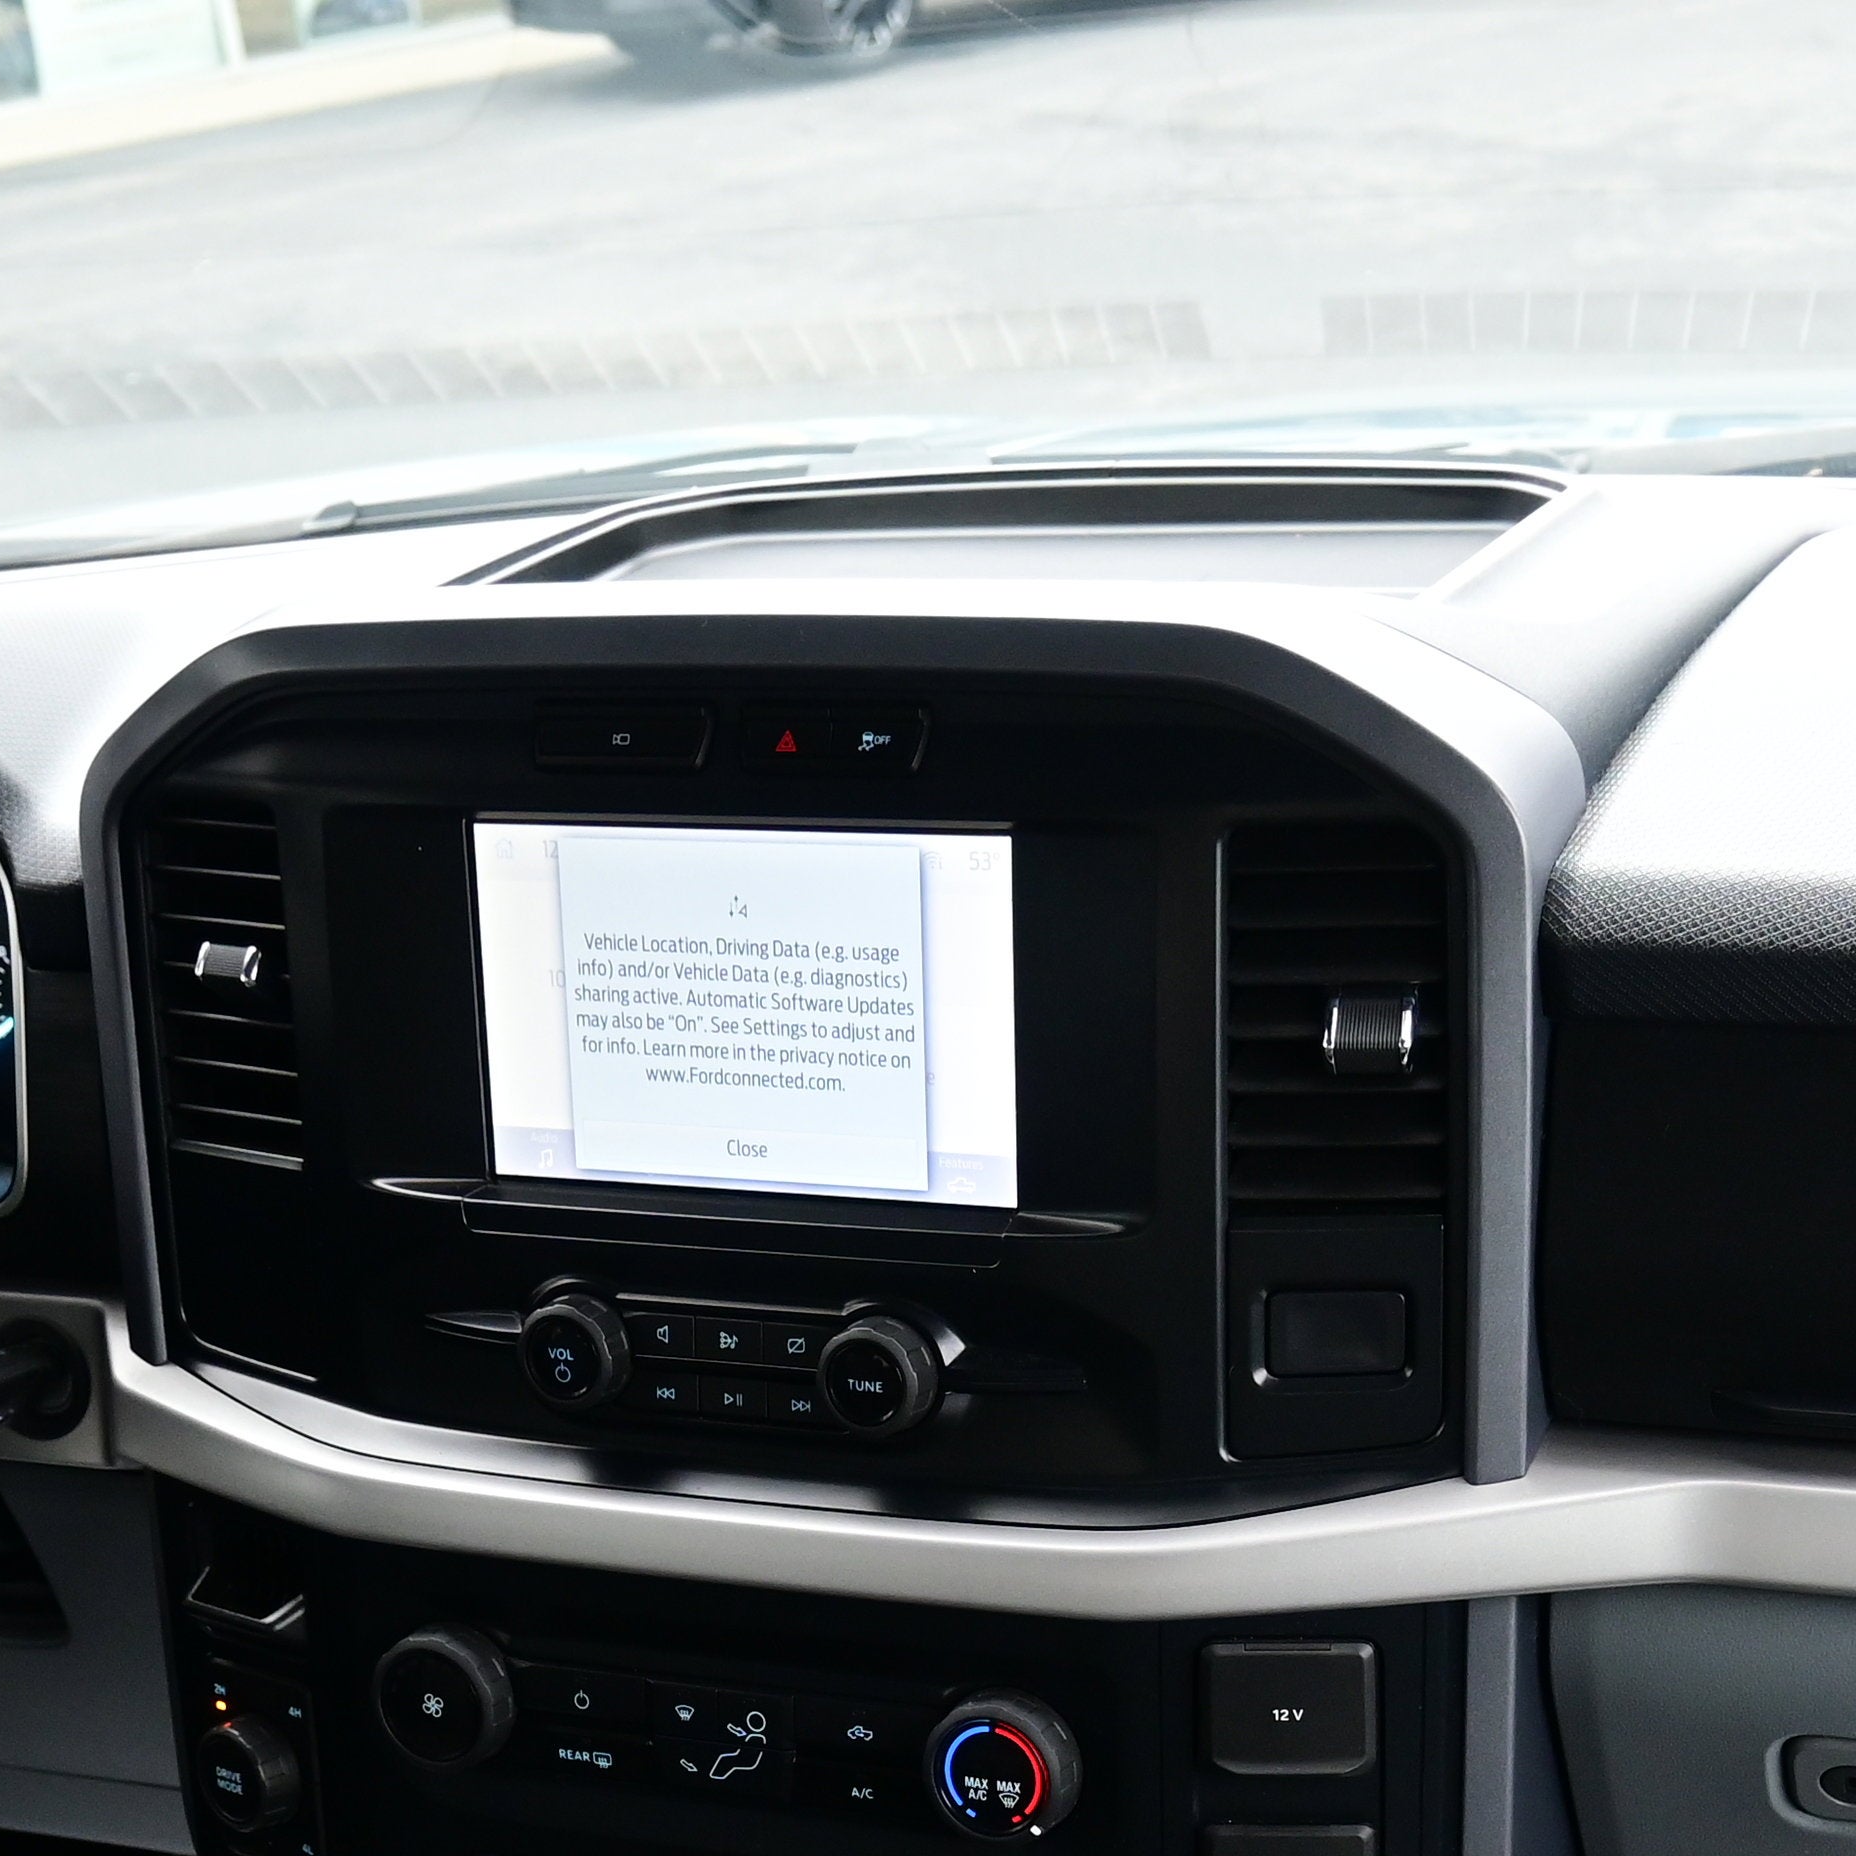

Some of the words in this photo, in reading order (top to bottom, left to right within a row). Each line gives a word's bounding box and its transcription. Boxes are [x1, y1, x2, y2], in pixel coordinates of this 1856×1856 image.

[874, 733, 891, 746] OFF
[584, 932, 638, 952] Vehicle
[642, 935, 713, 956] Location,
[716, 938, 769, 960] Driving
[773, 940, 810, 959] Data
[815, 941, 849, 963] (e.g.
[852, 946, 900, 965] usage
[577, 958, 614, 981] info)
[618, 961, 670, 980] and/or
[673, 962, 728, 982] Vehicle
[732, 965, 769, 983] Data
[774, 966, 807, 988] (e.g.
[810, 968, 908, 993] diagnostics)
[574, 984, 630, 1007] sharing
[633, 988, 683, 1006] active.
[686, 989, 767, 1010] Automatic
[771, 992, 844, 1013] Software
[847, 996, 915, 1017] Updates
[576, 1013, 608, 1031] may
[612, 1012, 643, 1030] also
[646, 1012, 665, 1031] be
[711, 1016, 739, 1034] See
[743, 1018, 808, 1040] Settings
[812, 1022, 828, 1039] to
[831, 1022, 880, 1043] adjust
[885, 1025, 915, 1043] and
[582, 1035, 604, 1053] for
[607, 1037, 640, 1056] info.
[643, 1039, 687, 1058] Learn
[690, 1044, 730, 1060] more
[733, 1043, 746, 1060] in
[750, 1044, 776, 1062] the
[780, 1046, 835, 1068] privacy
[838, 1049, 888, 1068] notice
[891, 1054, 911, 1069] on
[645, 1066, 846, 1092] www.Fordconnected.com.
[726, 1139, 768, 1160] Close
[547, 1347, 575, 1361] VOL
[847, 1378, 884, 1395] TUNE
[1272, 1708, 1290, 1721] 12
[1292, 1708, 1304, 1721] V
[558, 1748, 591, 1762] REAR
[215, 1766, 242, 1784] DRIVE
[964, 1776, 989, 1790] MAX
[216, 1778, 244, 1796] MODE
[851, 1787, 874, 1800] A/C
[968, 1789, 988, 1801] A/C
[996, 1780, 1021, 1794] MAX
